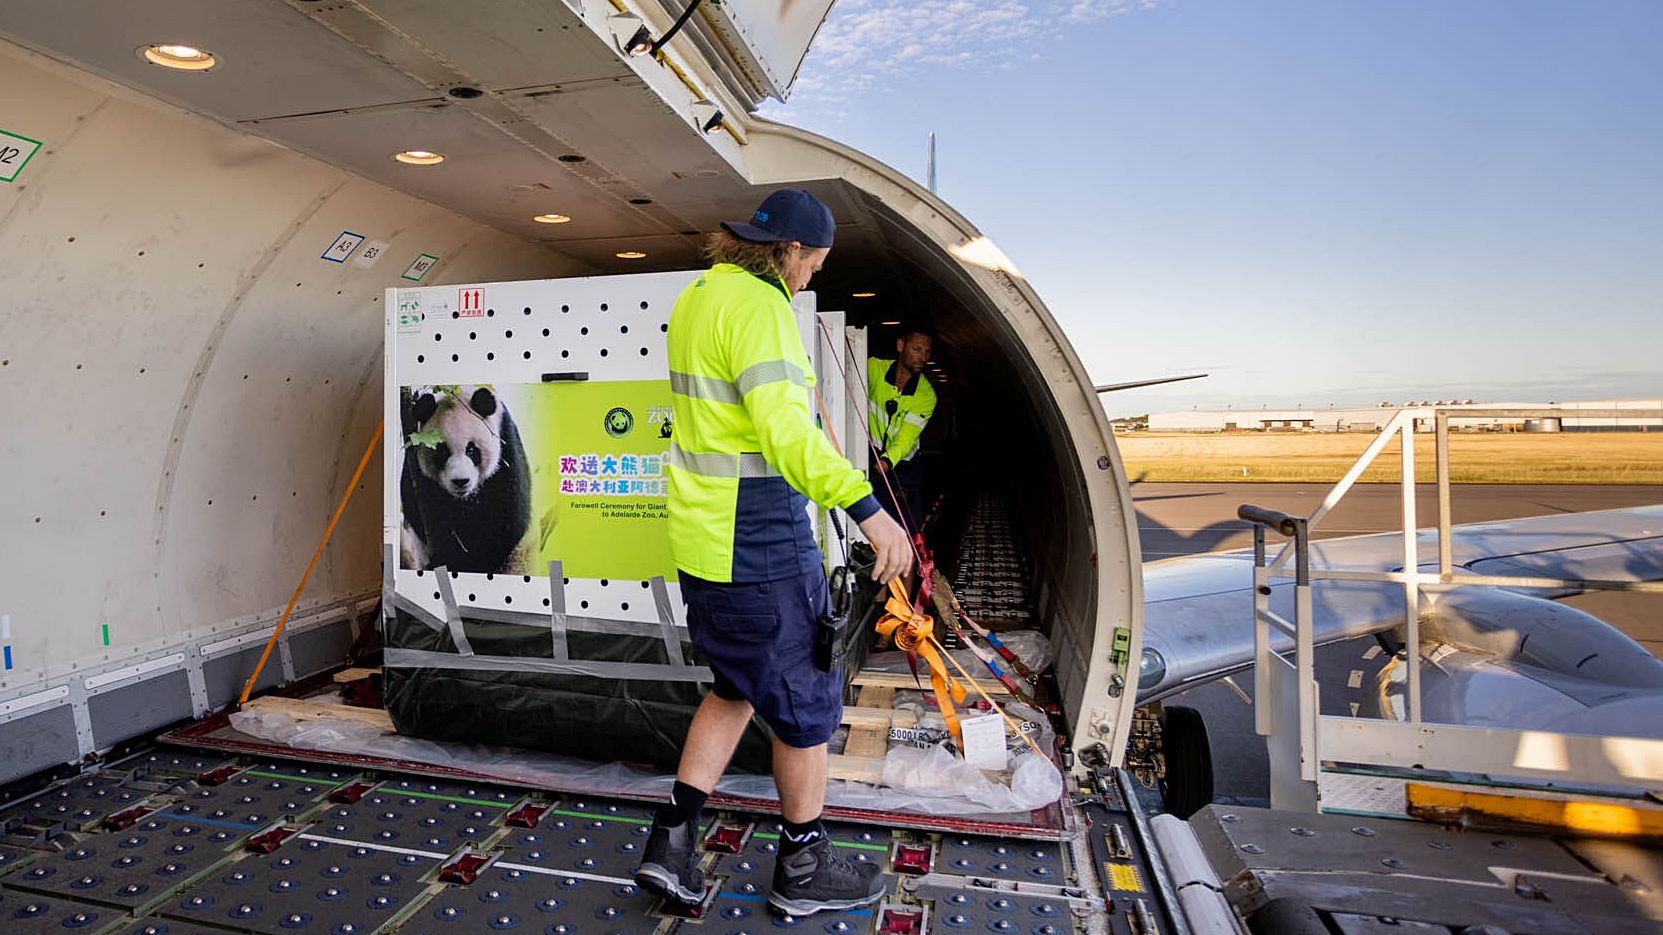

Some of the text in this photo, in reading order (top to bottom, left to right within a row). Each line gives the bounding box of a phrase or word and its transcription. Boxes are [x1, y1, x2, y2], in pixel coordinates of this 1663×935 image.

[335, 240, 353, 252] A3
[364, 247, 379, 259] B3
[571, 501, 599, 509] Farewell
[600, 502, 635, 511] Ceremony
[642, 511, 658, 519] Zoo,
